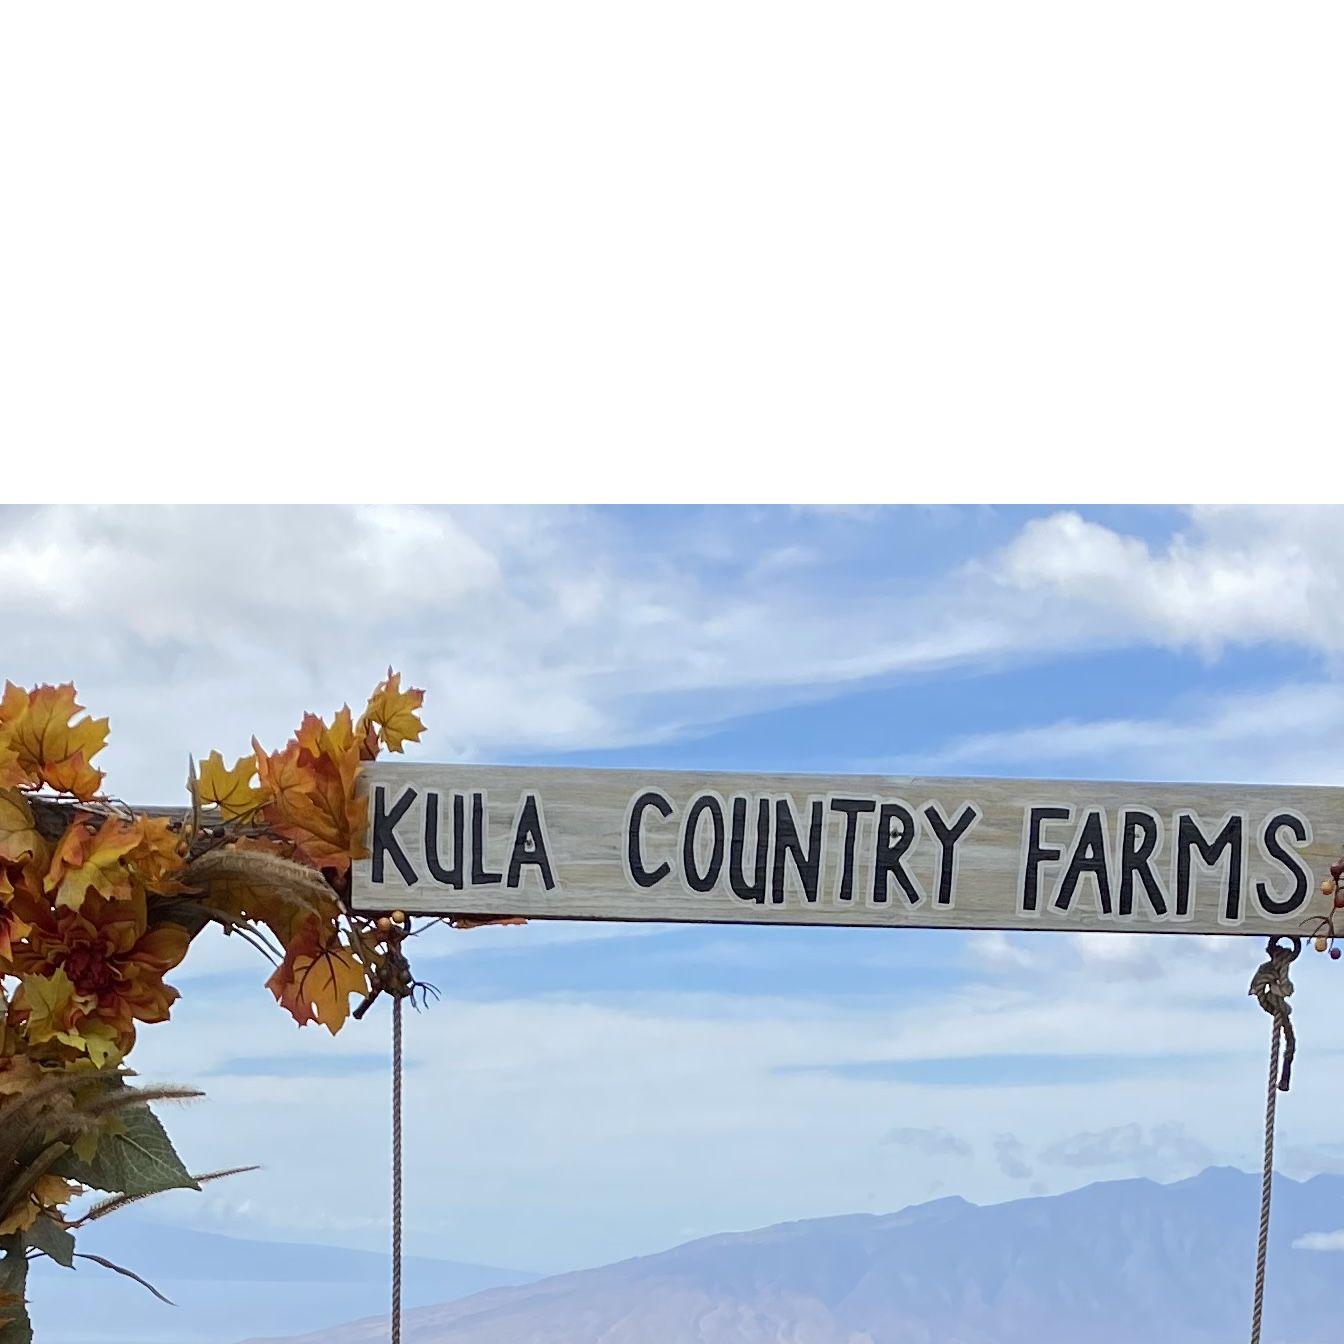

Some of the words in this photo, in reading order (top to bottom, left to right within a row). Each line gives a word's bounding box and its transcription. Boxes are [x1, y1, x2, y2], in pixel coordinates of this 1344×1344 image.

[370, 786, 554, 890] KULA
[629, 793, 976, 904] COUNTRY
[1022, 808, 1309, 921] FARMS
